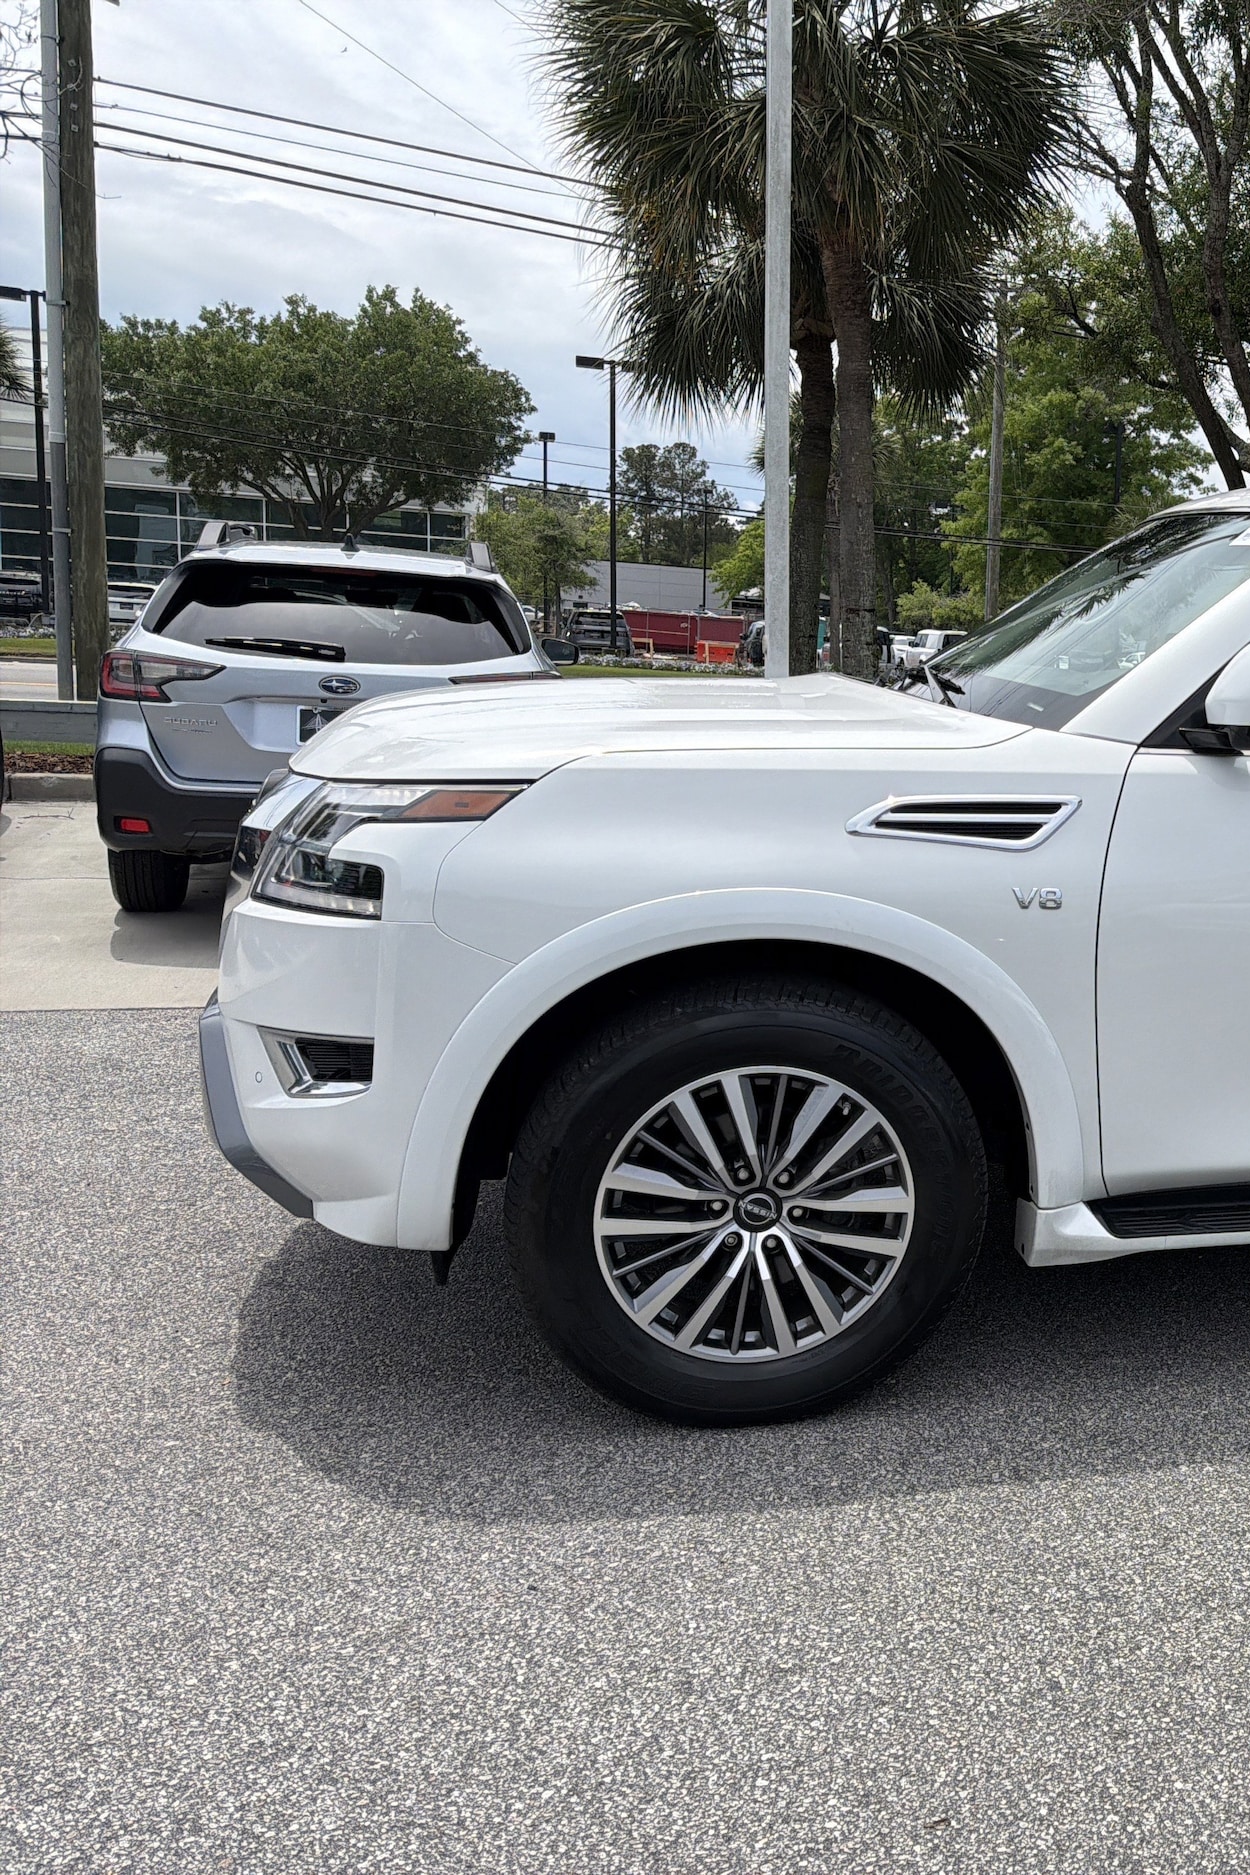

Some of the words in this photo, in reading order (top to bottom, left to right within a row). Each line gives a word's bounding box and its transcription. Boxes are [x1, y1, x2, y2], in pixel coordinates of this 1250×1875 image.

[163, 716, 218, 727] SUBARU
[1011, 887, 1062, 910] V8
[737, 1199, 778, 1220] NISSAN
